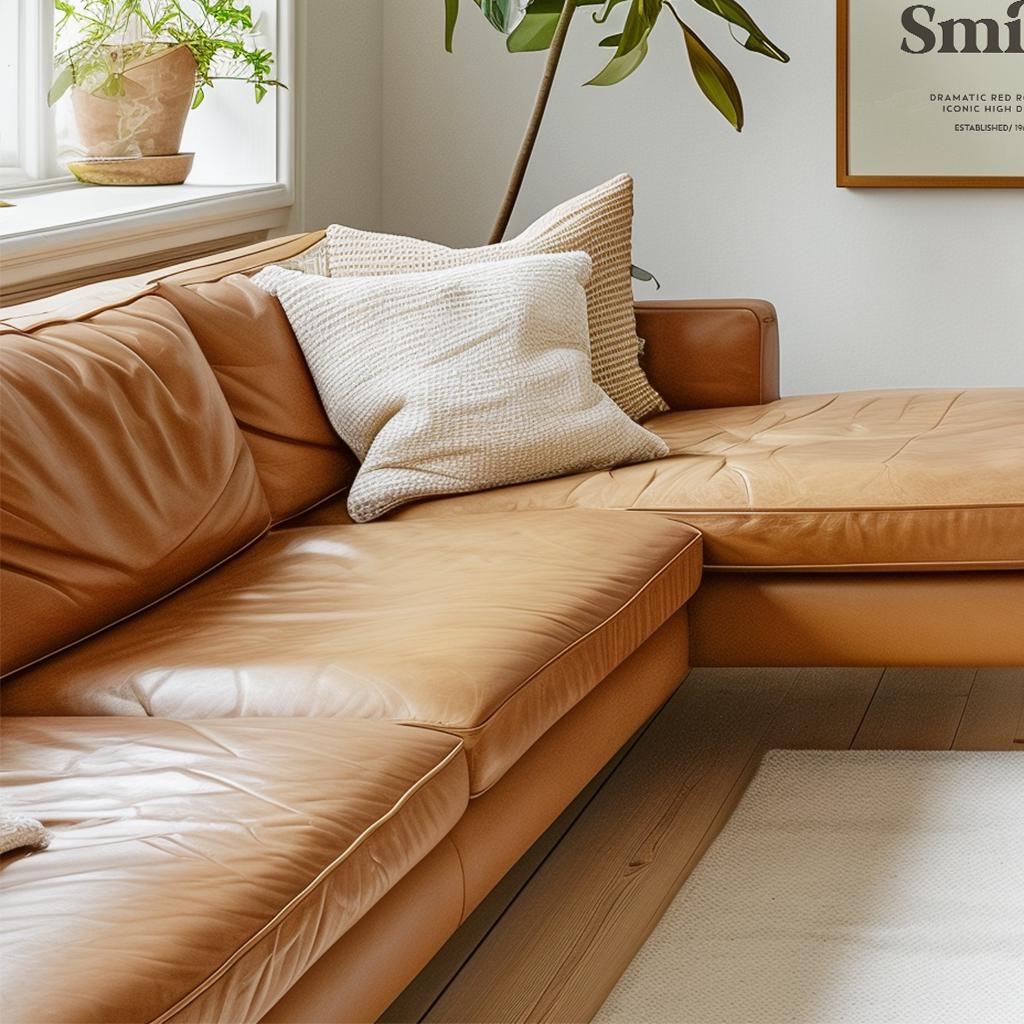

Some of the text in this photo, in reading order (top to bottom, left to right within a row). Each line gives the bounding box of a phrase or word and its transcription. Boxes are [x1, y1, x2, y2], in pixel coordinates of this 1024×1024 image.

[929, 93, 987, 102] DRAMATIC
[990, 93, 1012, 102] RED
[942, 104, 981, 113] ICONIC
[984, 104, 1012, 113] HIGH
[954, 123, 1013, 133] ESTABLISHED/
